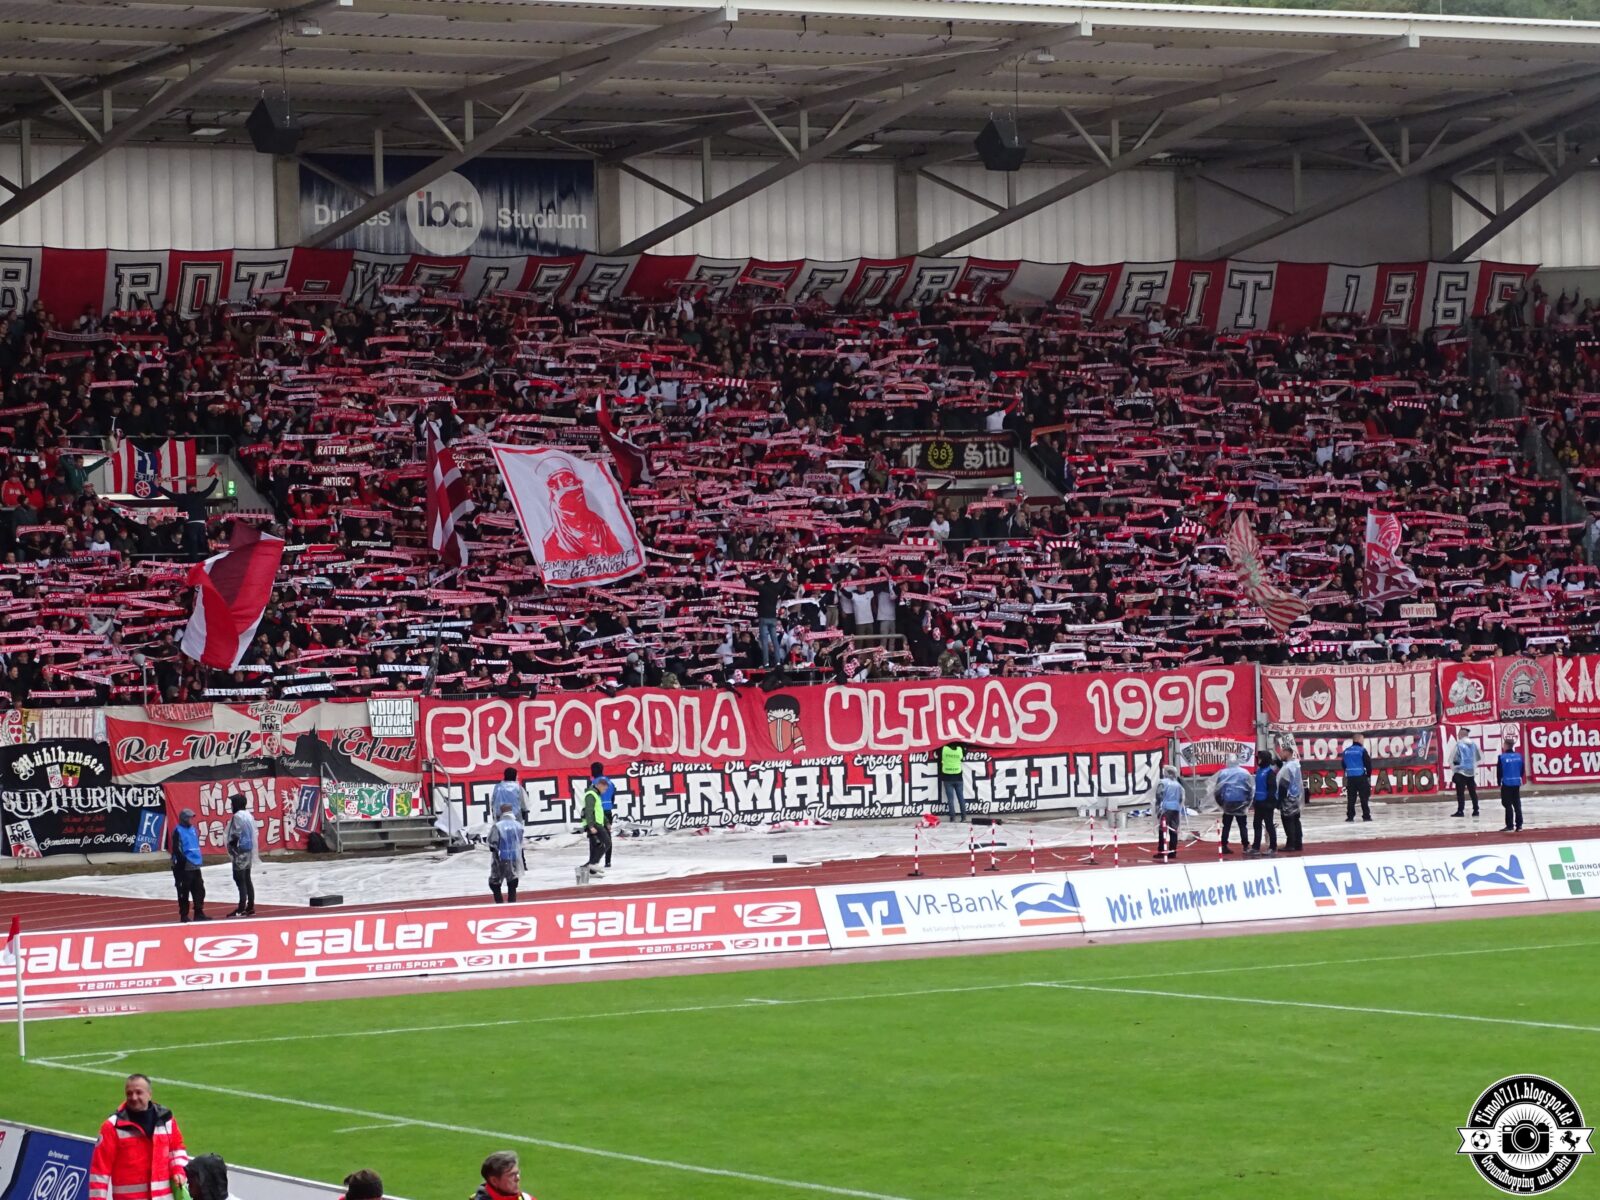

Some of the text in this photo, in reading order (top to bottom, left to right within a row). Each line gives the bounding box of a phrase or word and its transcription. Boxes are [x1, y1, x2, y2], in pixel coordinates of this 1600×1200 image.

[314, 204, 587, 229] Dues Studium
[417, 191, 473, 228] iba
[1061, 269, 1274, 329] SEIT
[317, 445, 347, 456] RATTEN!
[933, 449, 948, 460] 98
[964, 442, 1010, 469] Süd
[570, 560, 629, 579] GEDANKEN
[1556, 656, 1600, 703] KA
[264, 715, 277, 723] FC
[368, 700, 412, 714] NOORD
[824, 669, 1236, 752] ULTRAS 1996
[42, 718, 93, 739] BERLIN
[262, 722, 281, 731] RWE
[371, 714, 412, 727] TRIBUNE
[425, 692, 747, 774] ERFORDIA
[338, 728, 416, 762] Erfurt
[1531, 722, 1600, 748] Gotha
[1303, 738, 1338, 760] LOS
[11, 746, 105, 780] Mühlhausen
[626, 760, 665, 777] Einst
[801, 755, 844, 766] unserer
[854, 753, 902, 772] Erfolge
[909, 751, 929, 763] und
[200, 777, 277, 816] MAIN
[664, 811, 708, 829] Glanz
[716, 808, 763, 824] Deiner
[772, 807, 802, 822] alten
[804, 802, 846, 820] Tage
[853, 802, 894, 818] werden
[902, 804, 923, 816] wir
[931, 803, 949, 814] uns
[998, 796, 1038, 811] sehnen
[10, 823, 24, 836] FC
[10, 829, 33, 843] RWE
[39, 837, 81, 851] Gemeinsam
[80, 835, 92, 847] für
[1366, 860, 1460, 887] VR-Bank
[905, 888, 1009, 917] VR-Bank
[1107, 866, 1282, 923] Wir kümmern uns!
